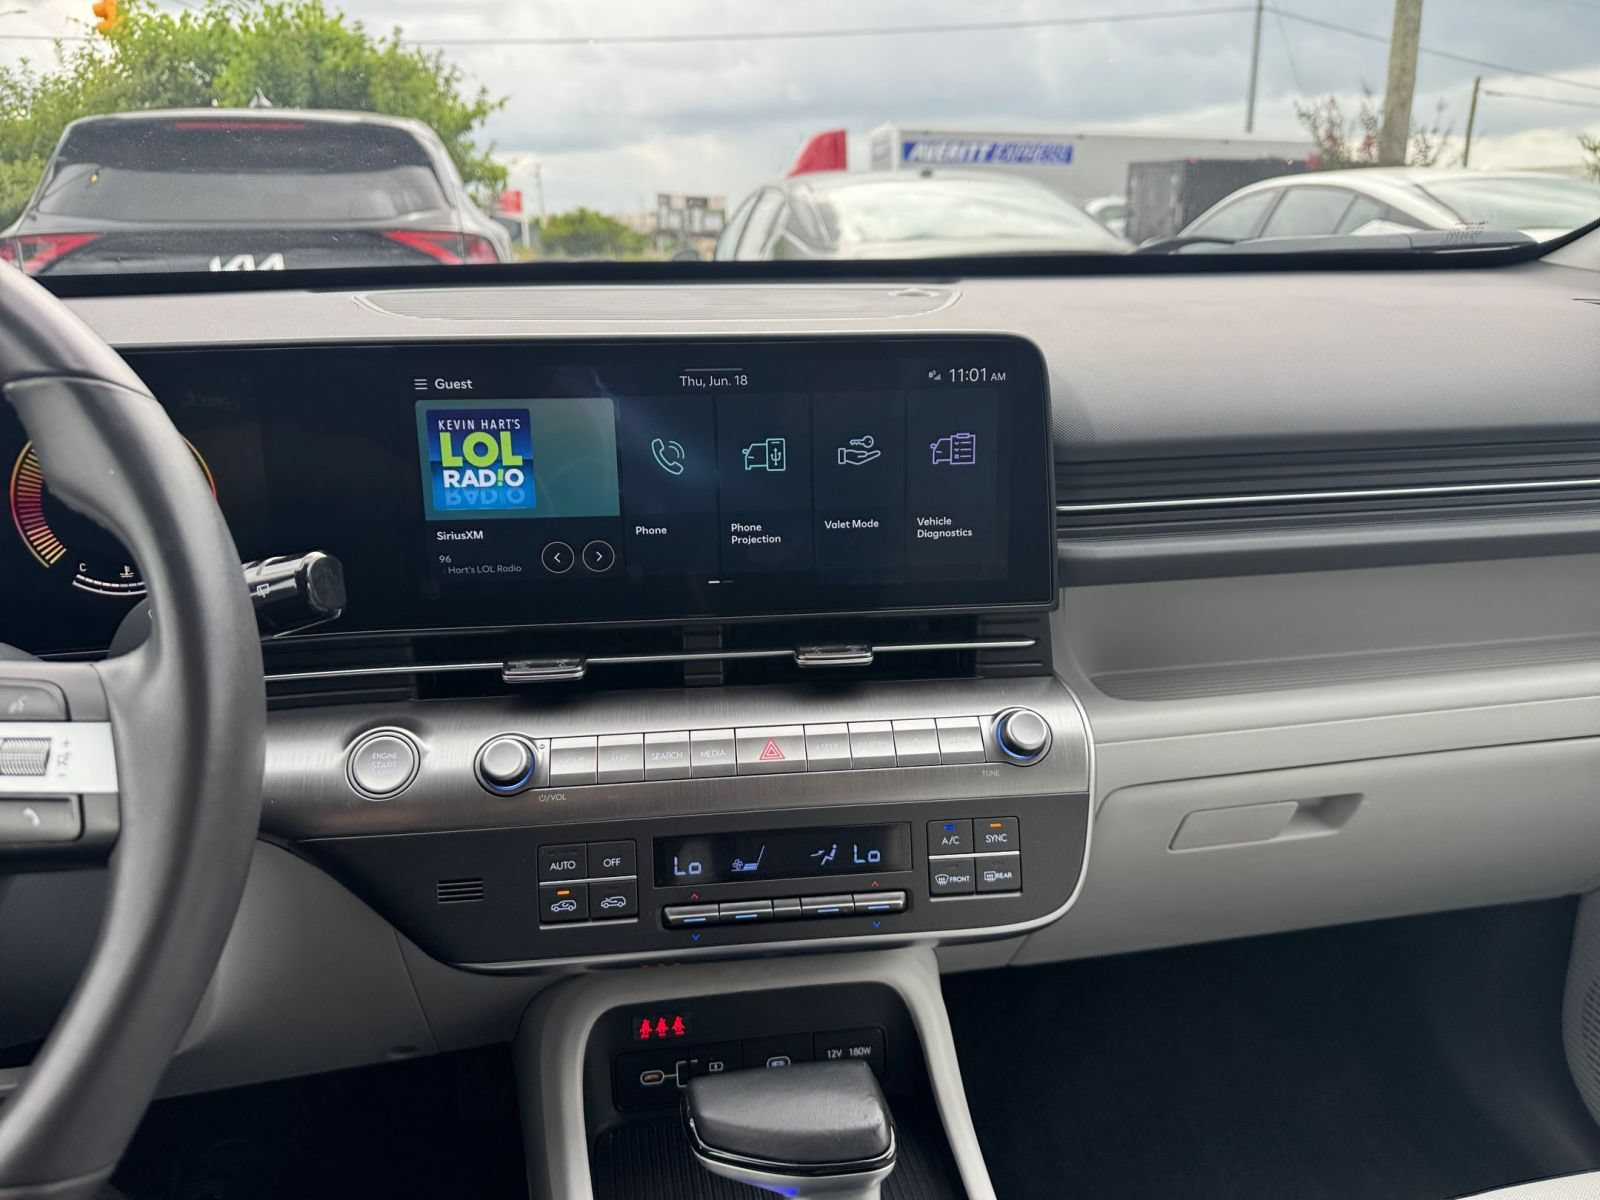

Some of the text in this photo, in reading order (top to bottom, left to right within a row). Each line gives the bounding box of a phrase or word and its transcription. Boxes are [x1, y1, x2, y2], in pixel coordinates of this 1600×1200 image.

[948, 367, 1007, 383] 11:01 AM
[434, 378, 473, 390] Guest
[679, 374, 748, 388] Thu, Jun. 18
[438, 418, 521, 430] KEVIN HART'S
[439, 431, 523, 467] LOL
[824, 518, 879, 529] Valet Mode
[917, 516, 952, 526] Vehicle
[635, 525, 668, 535] Phone
[731, 522, 762, 532] Phone
[436, 530, 484, 541] SiriusXM
[917, 527, 973, 539] Diagnostics
[731, 534, 782, 546] Projection
[438, 555, 452, 563] 96
[79, 563, 87, 572] C
[448, 564, 522, 574] Hart's LOL Radio
[372, 752, 399, 760] ENGINE
[651, 750, 683, 761] SEARCH
[700, 748, 726, 759] MEDIA
[981, 769, 1001, 778] TUNE
[941, 834, 960, 846] A/C
[985, 833, 1007, 843] SYNC
[853, 844, 880, 864] Lo
[550, 860, 576, 871] AUTO
[603, 857, 621, 868] OFF
[673, 856, 702, 876] Lo
[949, 874, 970, 883] FRONT
[995, 871, 1012, 879] REAR
[827, 1045, 872, 1059] 12V 180W
